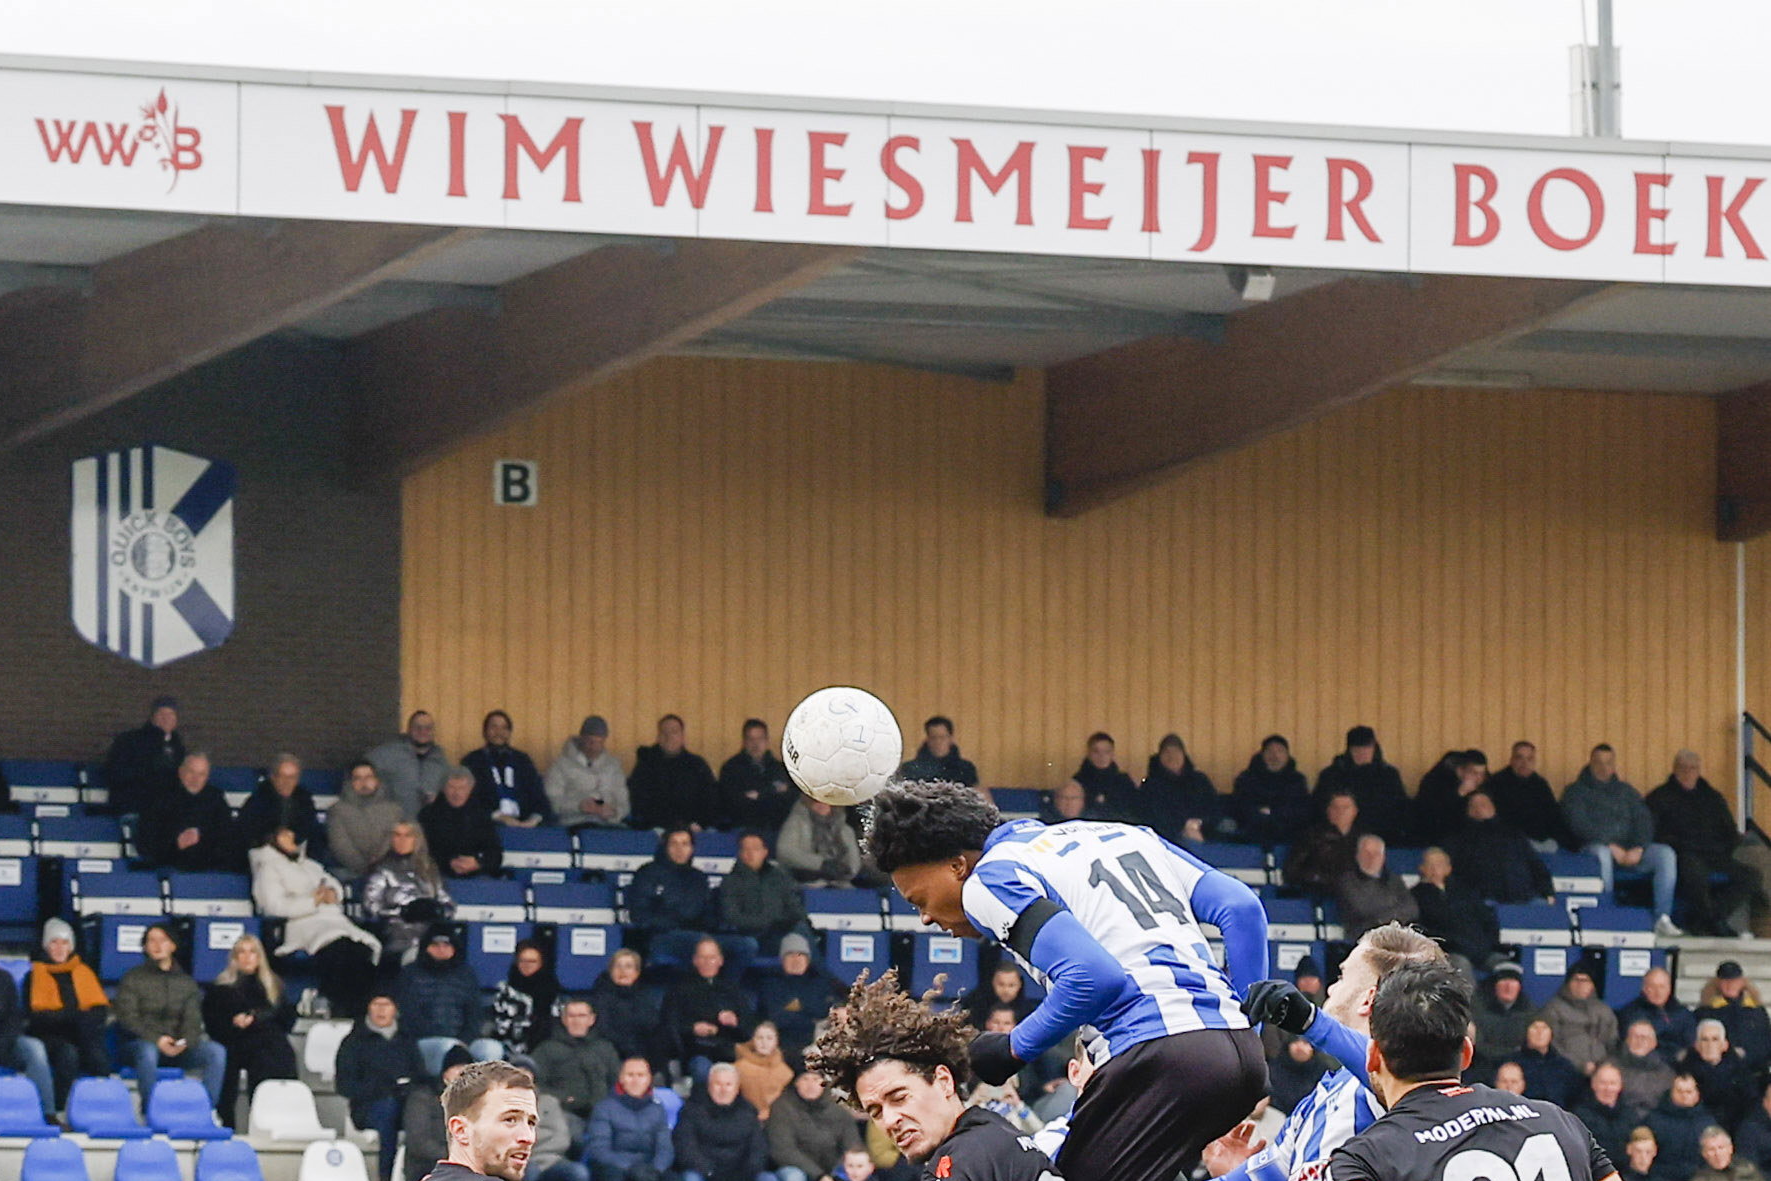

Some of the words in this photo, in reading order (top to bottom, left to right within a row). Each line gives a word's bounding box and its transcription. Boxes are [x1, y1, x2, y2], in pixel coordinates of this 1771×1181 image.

[323, 105, 585, 203] WIM
[632, 121, 1383, 252] WIESMEIJER
[1452, 163, 1769, 261] BOEK
[502, 464, 530, 503] B
[1088, 850, 1191, 931] 14
[1414, 1104, 1541, 1144] MODERNA.NL
